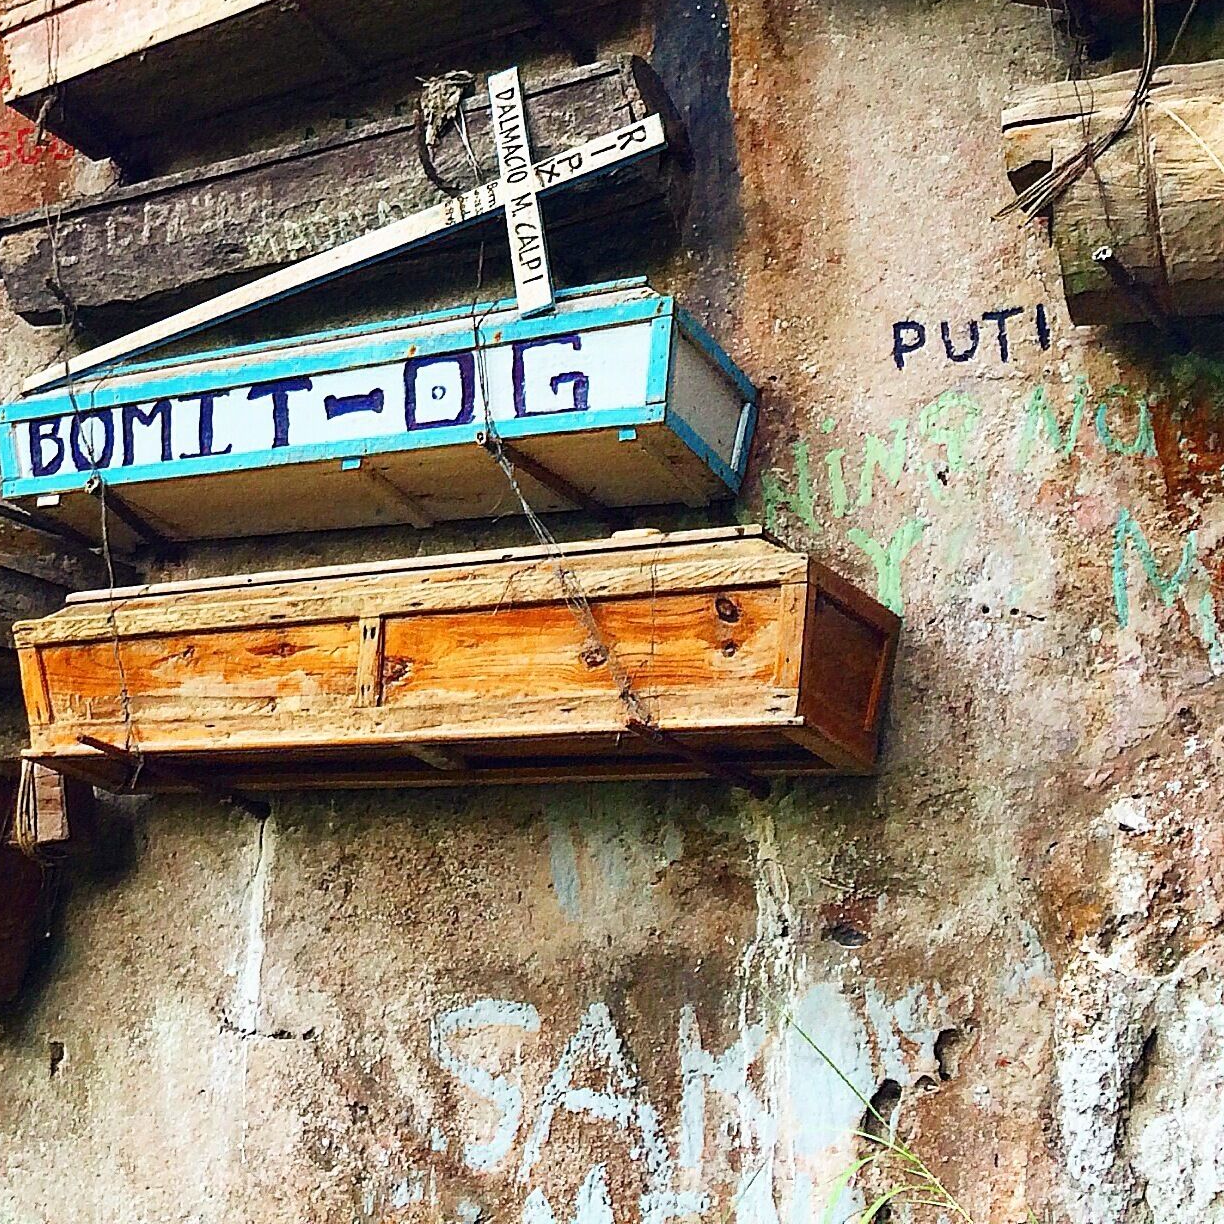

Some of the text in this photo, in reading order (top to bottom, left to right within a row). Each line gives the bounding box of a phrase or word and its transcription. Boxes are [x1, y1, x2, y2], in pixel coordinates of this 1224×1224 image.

[495, 87, 529, 185] DALMACIO
[514, 223, 545, 285] CALPI
[891, 303, 1052, 370] PUTI
